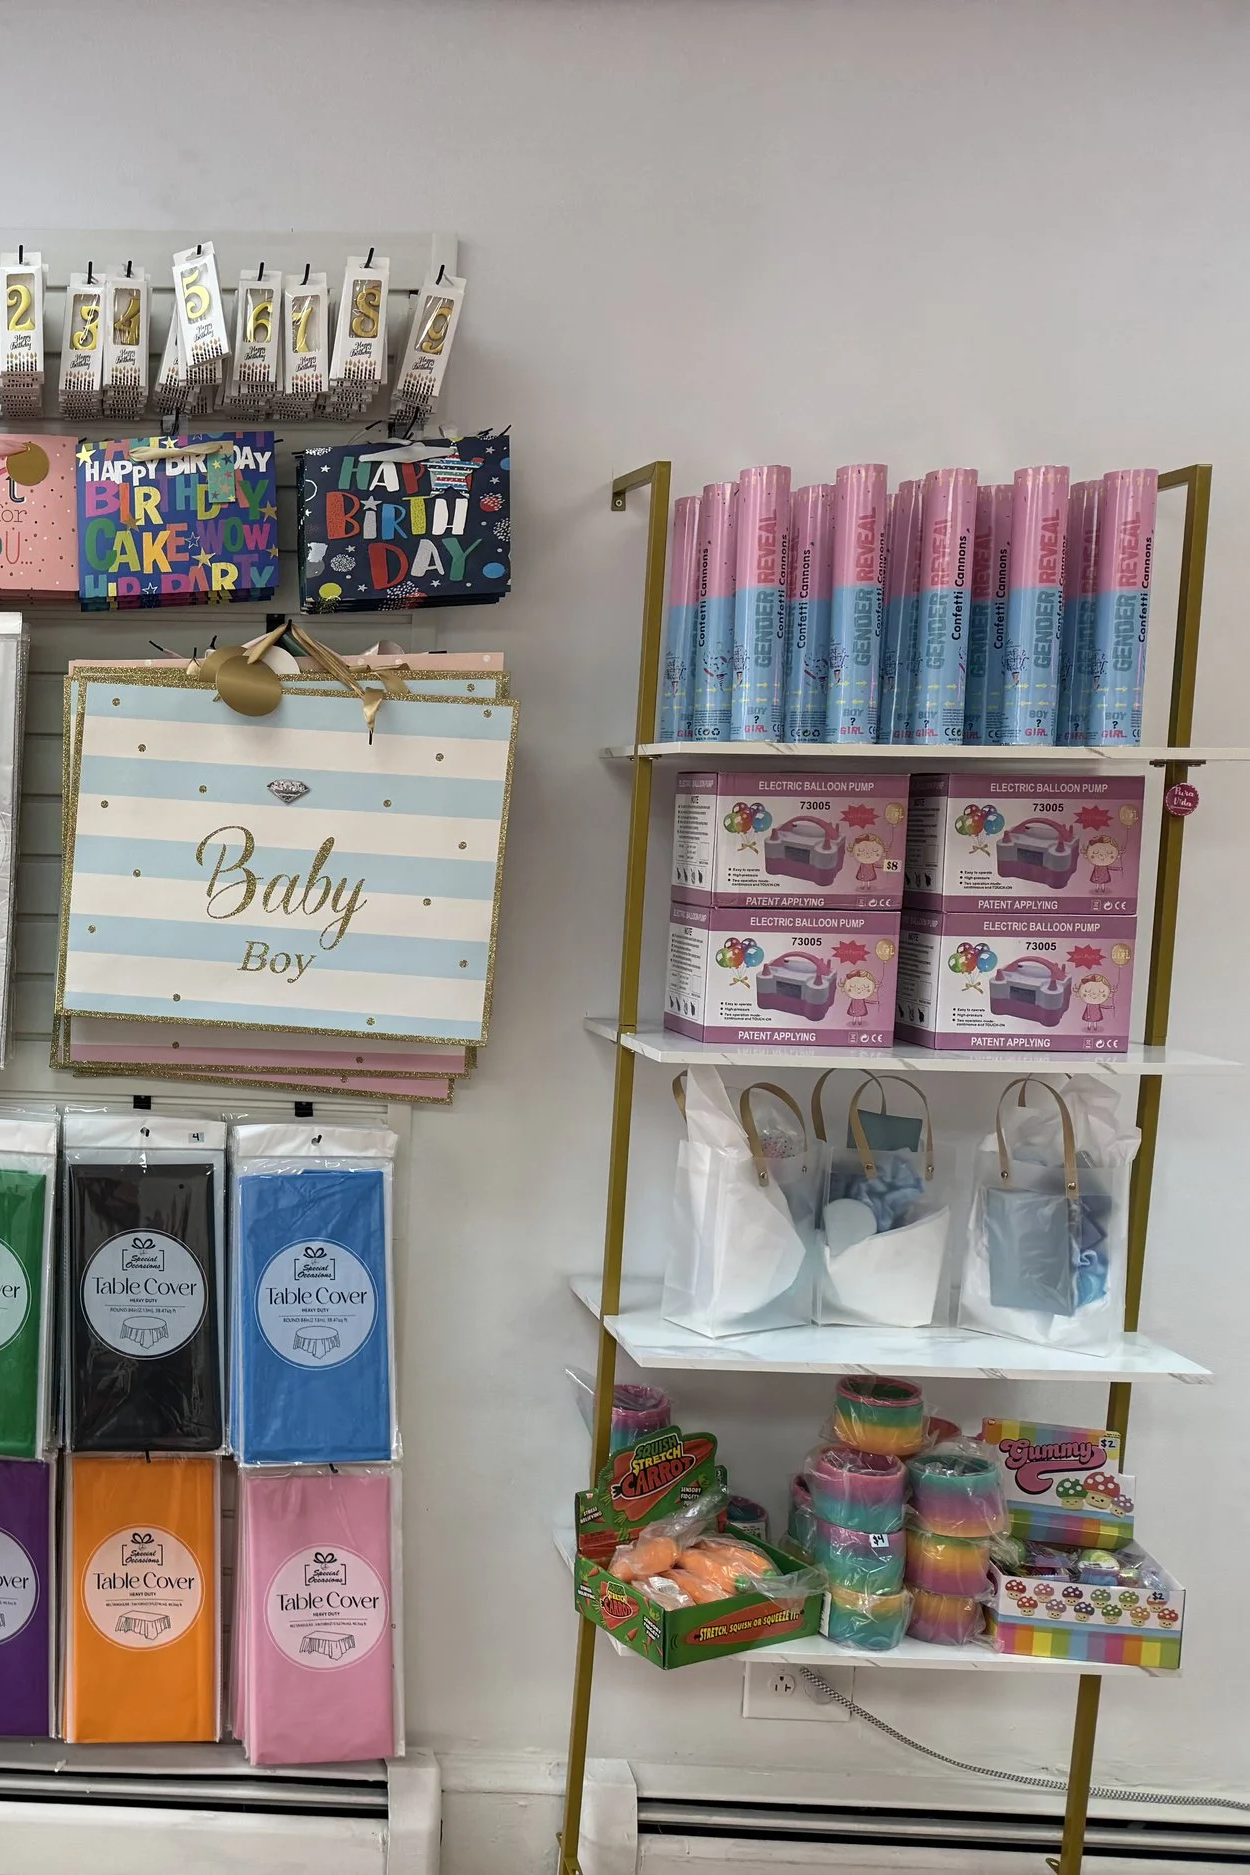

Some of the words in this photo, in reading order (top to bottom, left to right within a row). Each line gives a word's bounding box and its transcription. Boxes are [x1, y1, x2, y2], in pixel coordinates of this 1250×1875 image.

[7, 285, 35, 331] 2
[182, 270, 209, 319] 5
[352, 287, 380, 338] 8
[73, 306, 100, 350] 3
[247, 301, 272, 342] 6
[423, 307, 453, 353] 9
[86, 457, 158, 486] HAPPY
[166, 446, 271, 476] BIRDAY
[338, 457, 473, 494] HAP
[85, 518, 189, 573] CAKE
[196, 517, 270, 554] WOW
[368, 538, 483, 589] DAY
[757, 509, 777, 584] REVEAL
[954, 535, 967, 587] Cannons
[800, 549, 810, 598] Cannons
[754, 590, 775, 668] GENDER
[797, 601, 809, 649] Confetti
[952, 591, 963, 640] Confetti
[840, 725, 863, 735] GIRL
[887, 861, 898, 870] $8
[196, 825, 367, 951] Baby
[984, 922, 1027, 931] ELECTRIC
[1030, 922, 1073, 932] BALLOON
[1075, 923, 1100, 932] PUMP
[1025, 942, 1057, 951] 73005
[237, 940, 317, 983] Boy
[971, 1037, 1004, 1047] PATENT
[1006, 1038, 1050, 1048] APPLYING
[266, 1288, 312, 1304] Table
[316, 1287, 368, 1306] Cover
[632, 1446, 682, 1476] STRETCH
[634, 1434, 678, 1460] SQUISH
[999, 1438, 1093, 1470] Gummy
[1101, 1439, 1116, 1448] $2
[620, 1456, 694, 1498] CARROT
[873, 1534, 884, 1546] $4
[276, 1593, 324, 1610] Table
[328, 1592, 379, 1609] Cover
[1151, 1591, 1165, 1601] $2
[728, 1620, 752, 1633] SQUISH
[754, 1618, 762, 1626] OR
[763, 1610, 790, 1624] SQUEEZE
